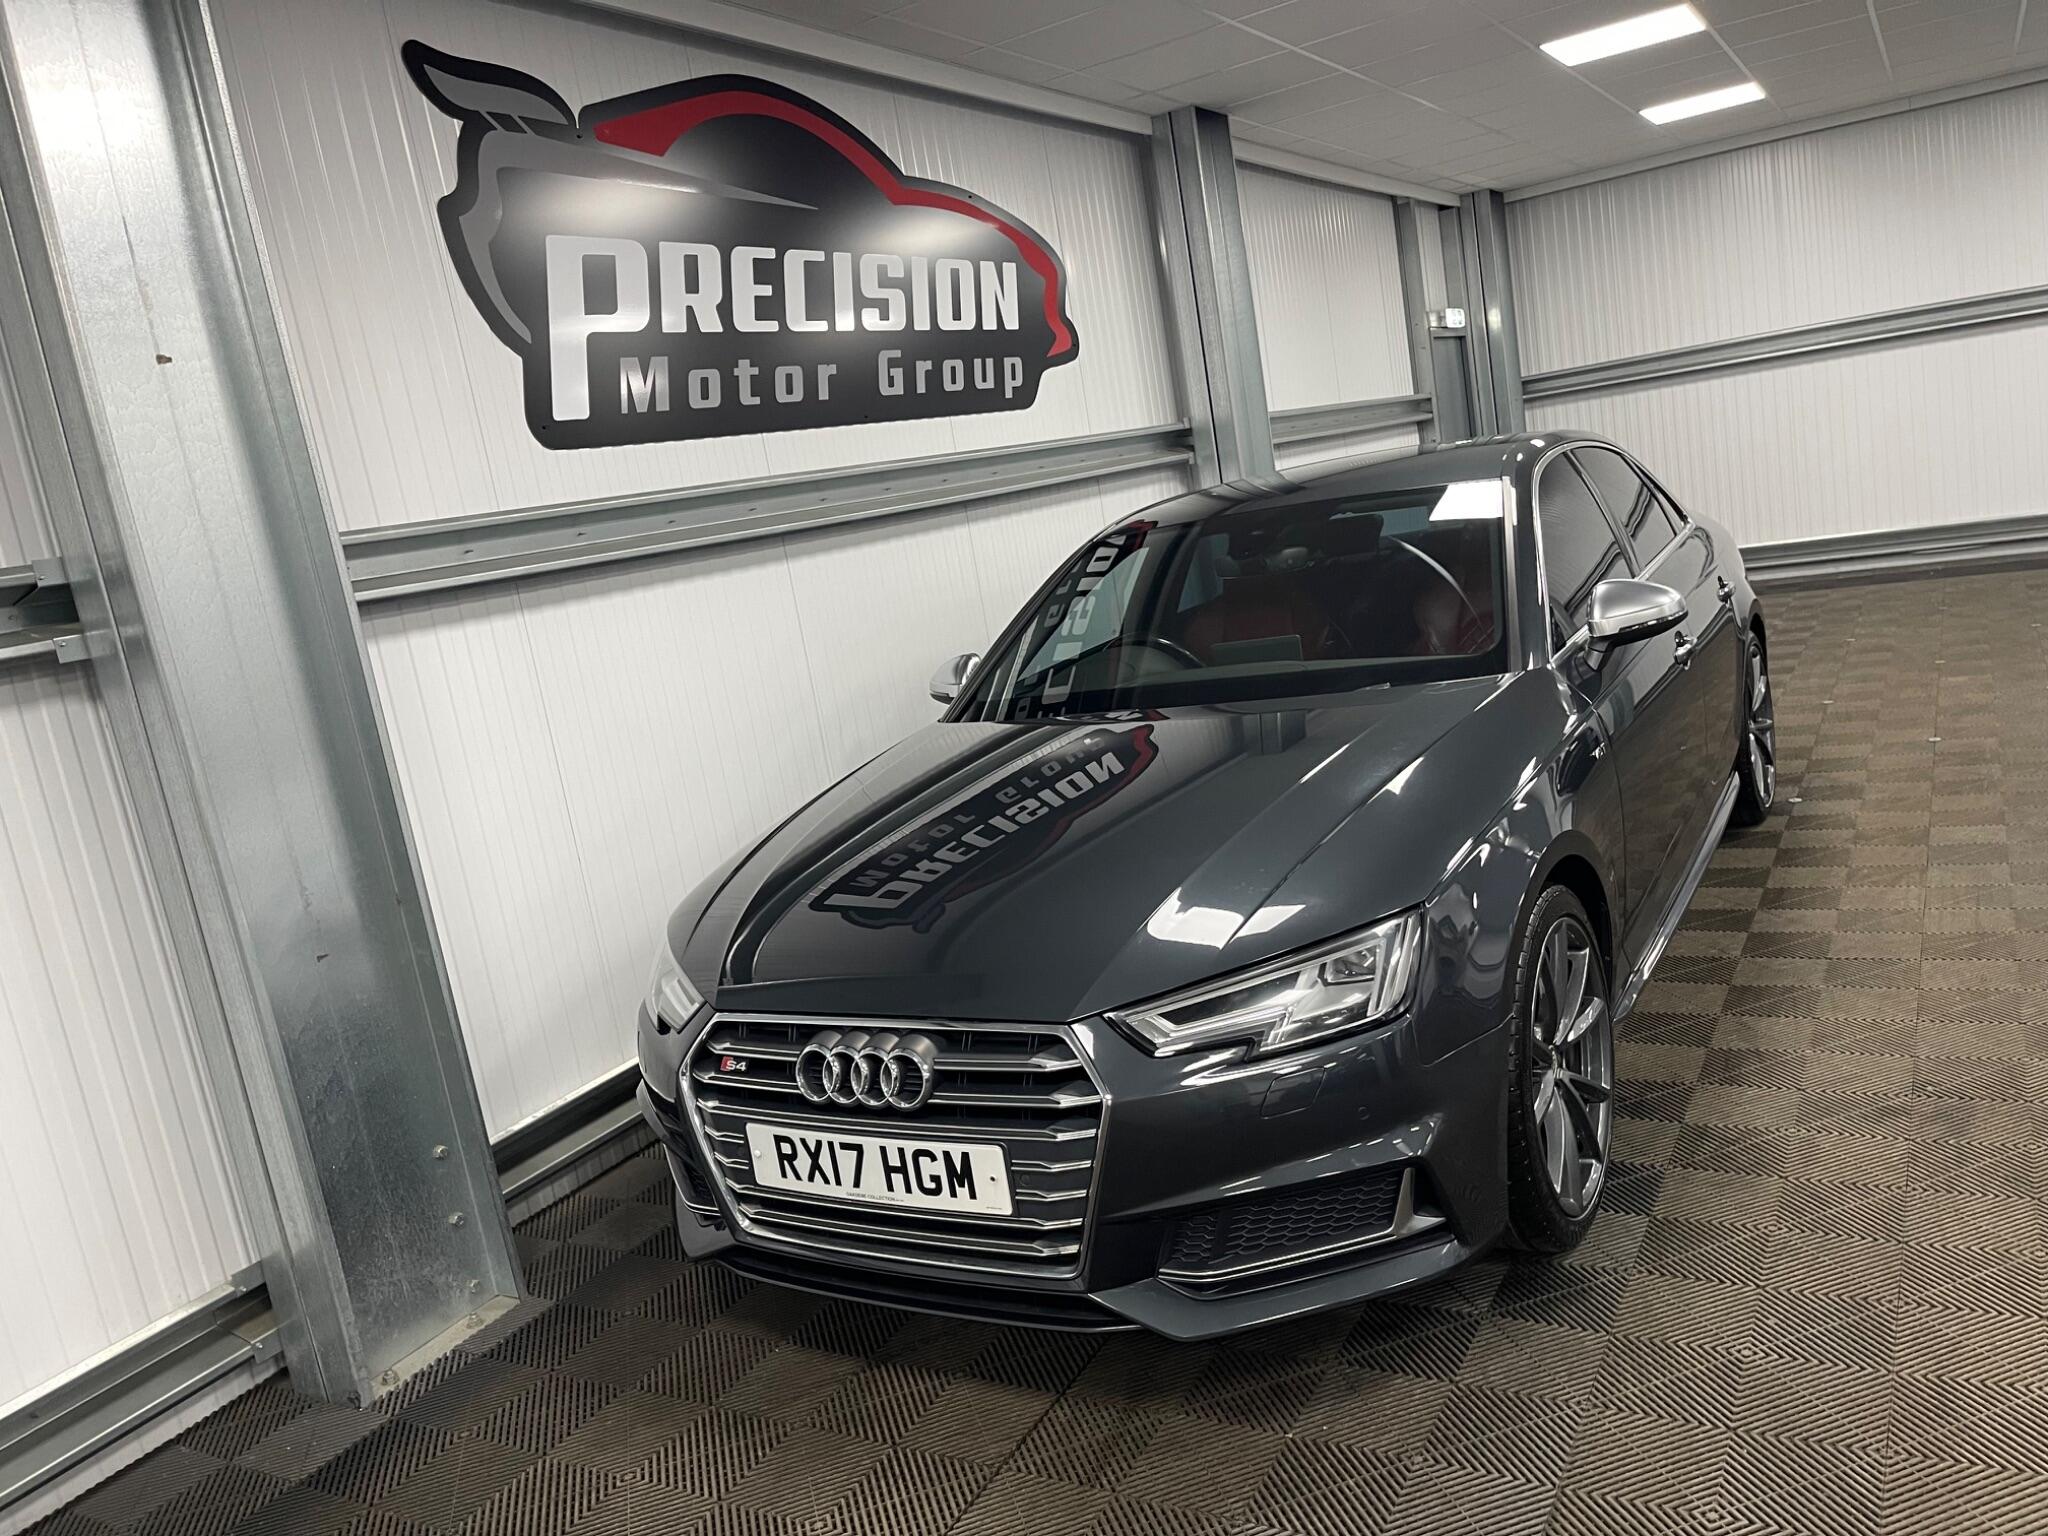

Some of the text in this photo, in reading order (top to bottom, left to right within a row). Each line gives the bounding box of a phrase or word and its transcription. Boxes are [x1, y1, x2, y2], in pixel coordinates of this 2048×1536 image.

[545, 235, 1020, 421] PRECISION
[620, 350, 1024, 414] Motor Group
[724, 1059, 747, 1072] S4
[773, 1134, 979, 1200] RX17 HGM
